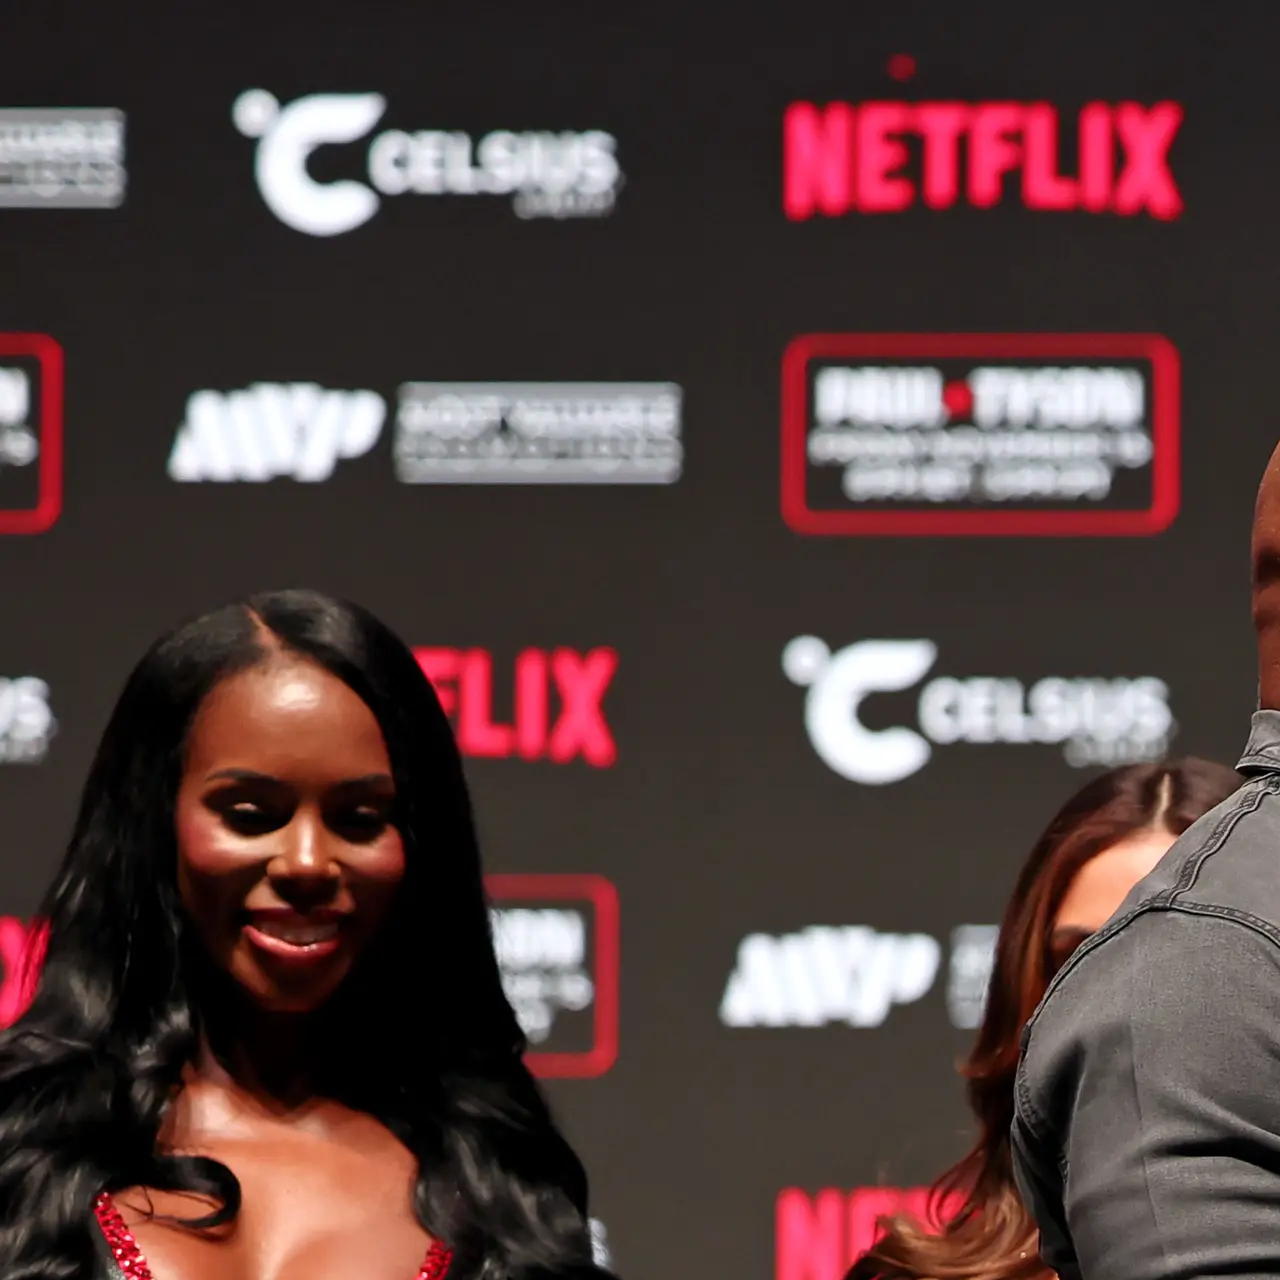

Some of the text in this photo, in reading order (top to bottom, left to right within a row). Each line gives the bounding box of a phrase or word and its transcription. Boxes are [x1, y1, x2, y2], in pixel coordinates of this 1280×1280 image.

[368, 130, 620, 194] CELSIUS
[783, 100, 1183, 220] NETFLIX
[918, 676, 1173, 742] CELSIUS
